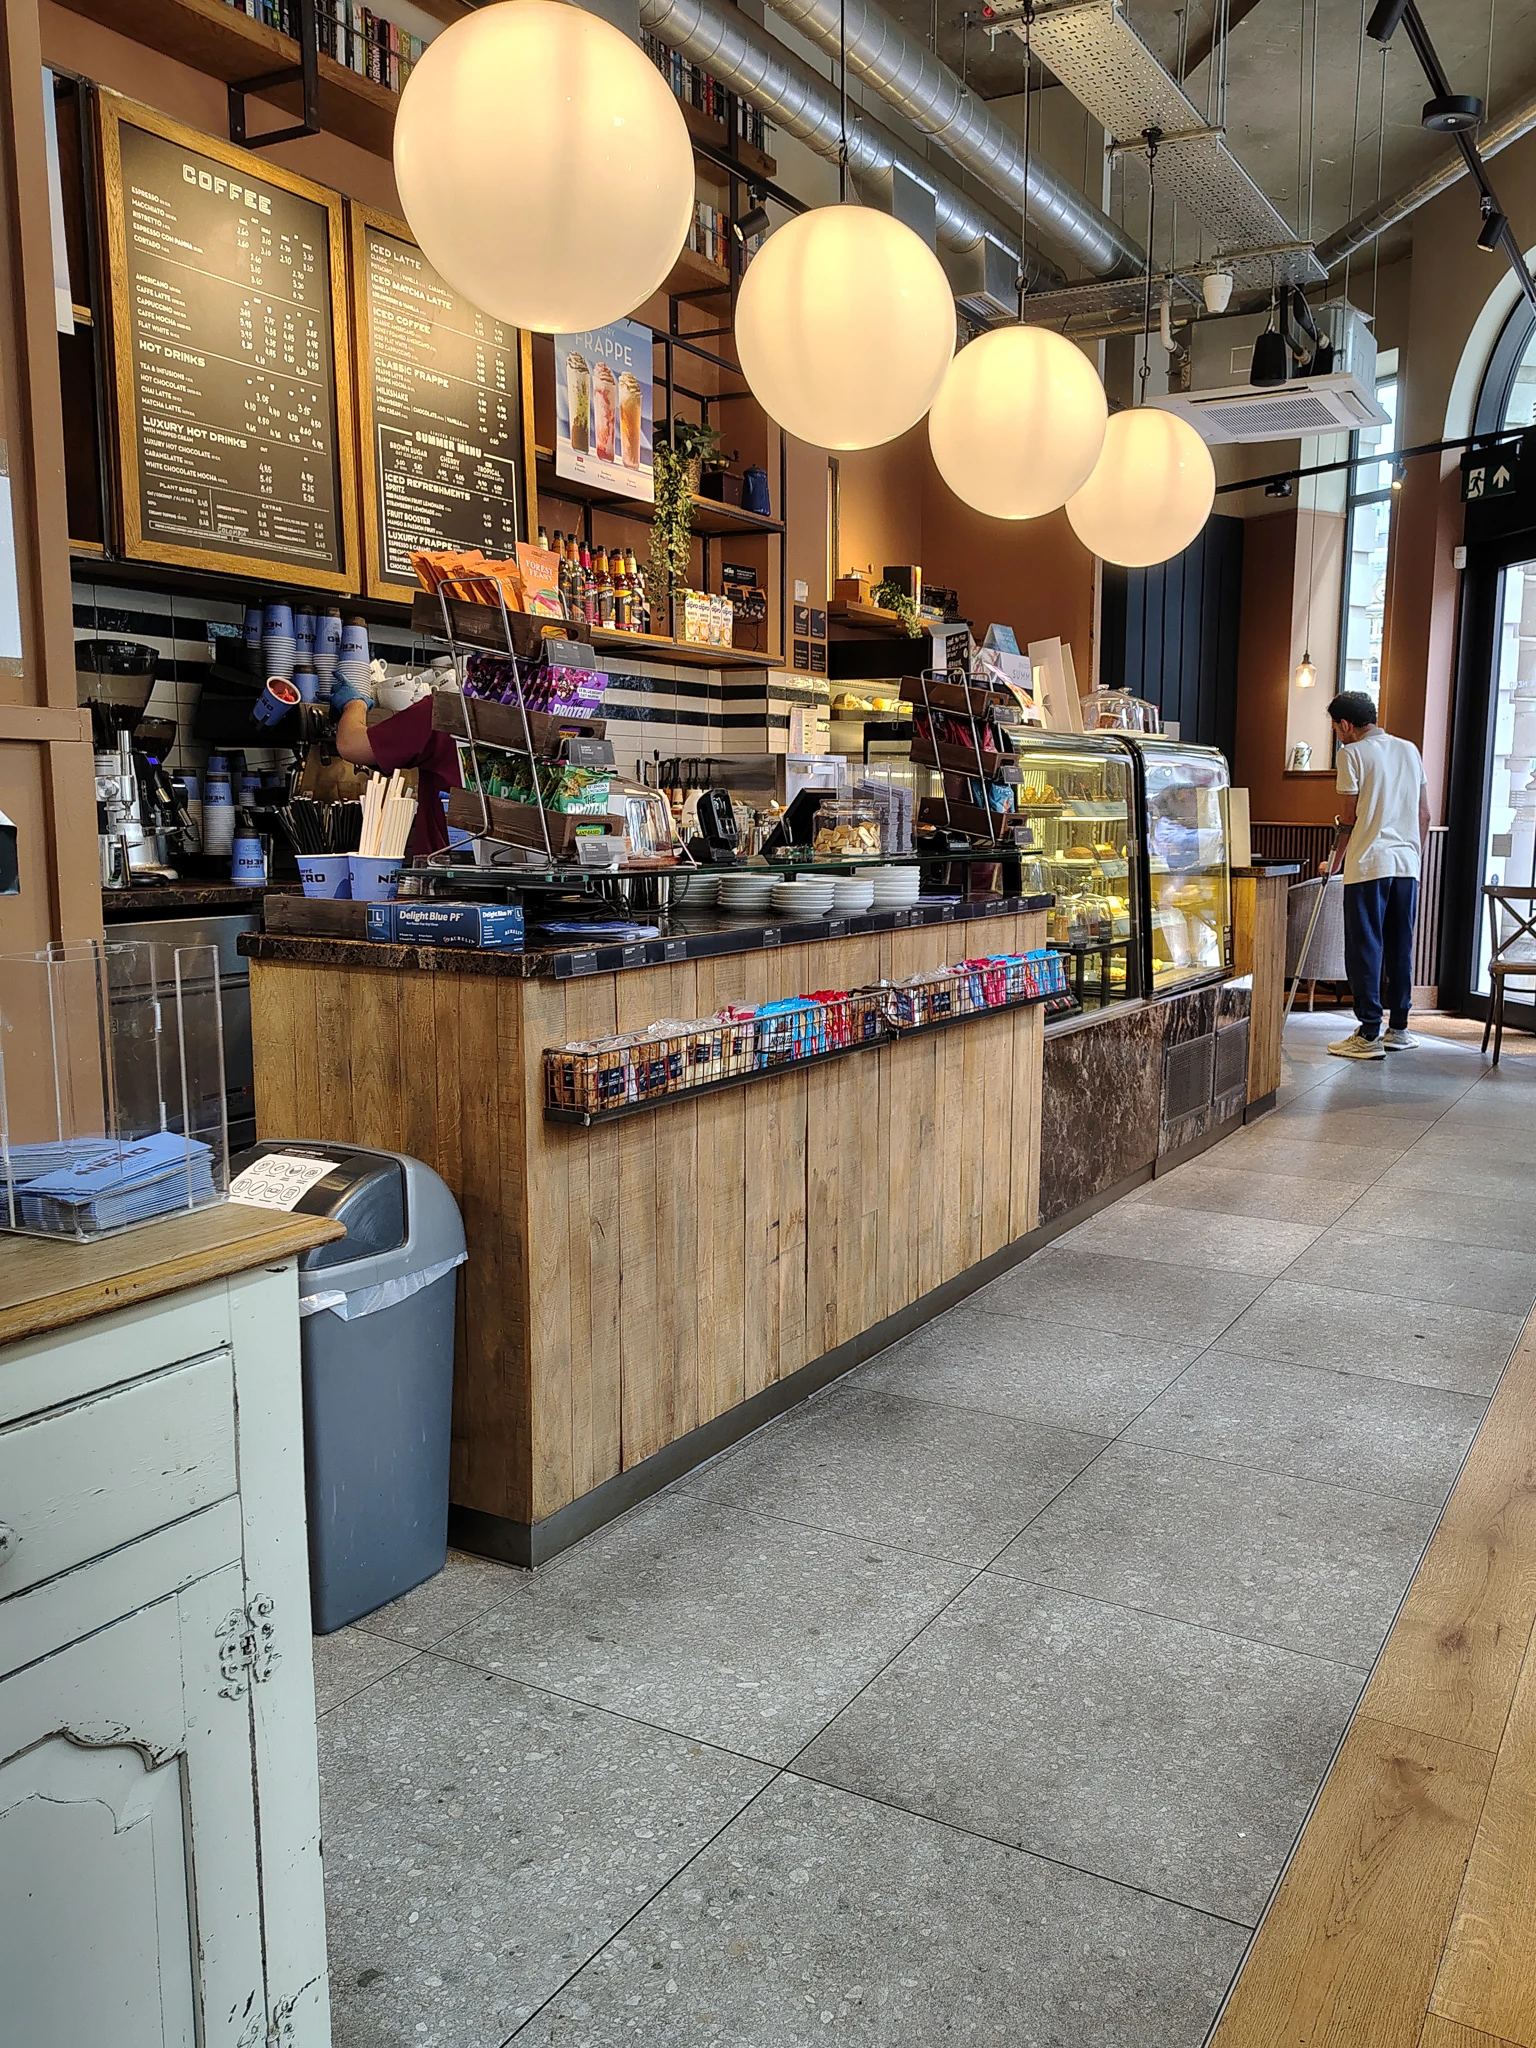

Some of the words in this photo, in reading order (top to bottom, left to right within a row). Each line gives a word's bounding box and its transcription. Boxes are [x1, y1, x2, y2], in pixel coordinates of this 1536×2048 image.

[132, 186, 159, 202] ESPRESSO
[182, 164, 272, 215] COFFEE
[132, 198, 164, 216] MACCHIATO
[133, 210, 162, 228] RISTRETTO
[133, 222, 160, 238] ESPRESSO
[161, 233, 174, 244] CON
[174, 237, 193, 250] PANNA
[134, 234, 160, 250] CORTADO
[370, 242, 391, 258] ICED
[394, 251, 421, 270] LATTE
[371, 253, 388, 265] CLASSIC
[136, 273, 168, 289] AMERICANO
[136, 284, 154, 296] CAFFE
[154, 290, 171, 302] LATTE
[371, 273, 391, 287] ICED
[392, 281, 425, 300] MATCHA
[426, 294, 452, 310] LATTE
[137, 297, 172, 314] CAPPUCCINO
[137, 308, 155, 319] CAFFE
[156, 314, 176, 327] MOCHA
[373, 307, 394, 321] ICED
[396, 315, 431, 334] COFFEE
[138, 320, 151, 330] FLAT
[152, 324, 169, 336] WHITE
[139, 340, 162, 355] HOT
[164, 347, 206, 368] DRINKS
[576, 332, 632, 367] FRAPPE
[140, 362, 150, 371] TEA
[156, 366, 184, 380] INFUSIONS
[375, 356, 412, 375] CLASSIC
[414, 368, 449, 388] FRAPPE
[140, 374, 152, 383] HOT
[153, 377, 186, 392] CHOCOLATE
[141, 385, 155, 395] CHAI
[156, 389, 172, 400] LATTE
[376, 386, 409, 402] MILKSHAKE
[142, 397, 164, 408] MATCHA
[165, 402, 181, 413] LATTE
[377, 396, 403, 409] STRAWBERRY
[413, 407, 437, 419] CHOCOLATE
[447, 416, 462, 426] VANILLA
[386, 408, 400, 417] CREAM
[142, 415, 184, 433] LUXURY
[186, 426, 208, 440] HOT
[210, 431, 247, 449] DRINKS
[143, 426, 156, 434] WITH
[178, 434, 194, 443] CREAM
[144, 438, 165, 448] LUXURY
[166, 442, 178, 451] HOT
[178, 445, 210, 459] CHOCOLATE
[390, 442, 410, 454] BROWN
[410, 448, 427, 458] SUGAR
[415, 431, 455, 452] SUMMER
[457, 442, 481, 458] MENU
[144, 449, 182, 464] CARAMELATTE
[440, 455, 460, 466] CHERRY
[145, 460, 163, 470] WHITE
[164, 463, 196, 478] CHOCOLATE
[197, 471, 217, 482] MOCHA
[477, 465, 500, 477] TROPICAL
[160, 482, 178, 492] PLANT
[179, 486, 198, 495] BASED
[385, 473, 405, 485] ICED
[406, 478, 471, 501] REFRESHMENTS
[386, 483, 405, 494] SPRITZ
[262, 503, 282, 512] EXTRAS
[386, 500, 413, 512] STRAWBERRY
[414, 505, 434, 516] LEMONADE
[394, 493, 411, 504] PASSION
[411, 497, 422, 506] FRUIT
[423, 499, 444, 511] LEMONADE
[387, 509, 404, 520] FRUIT
[404, 512, 430, 525] BOOSTER
[387, 518, 403, 527] MANGO
[407, 523, 424, 532] PASSION
[424, 526, 436, 534] FRUIT
[388, 531, 418, 546] LUXURY
[420, 536, 453, 550] FRAPPE
[388, 540, 408, 549] ESPRESSO
[301, 874, 325, 883] ERO
[376, 912, 381, 921] L
[400, 911, 428, 922] Delight
[430, 912, 448, 920] Blue
